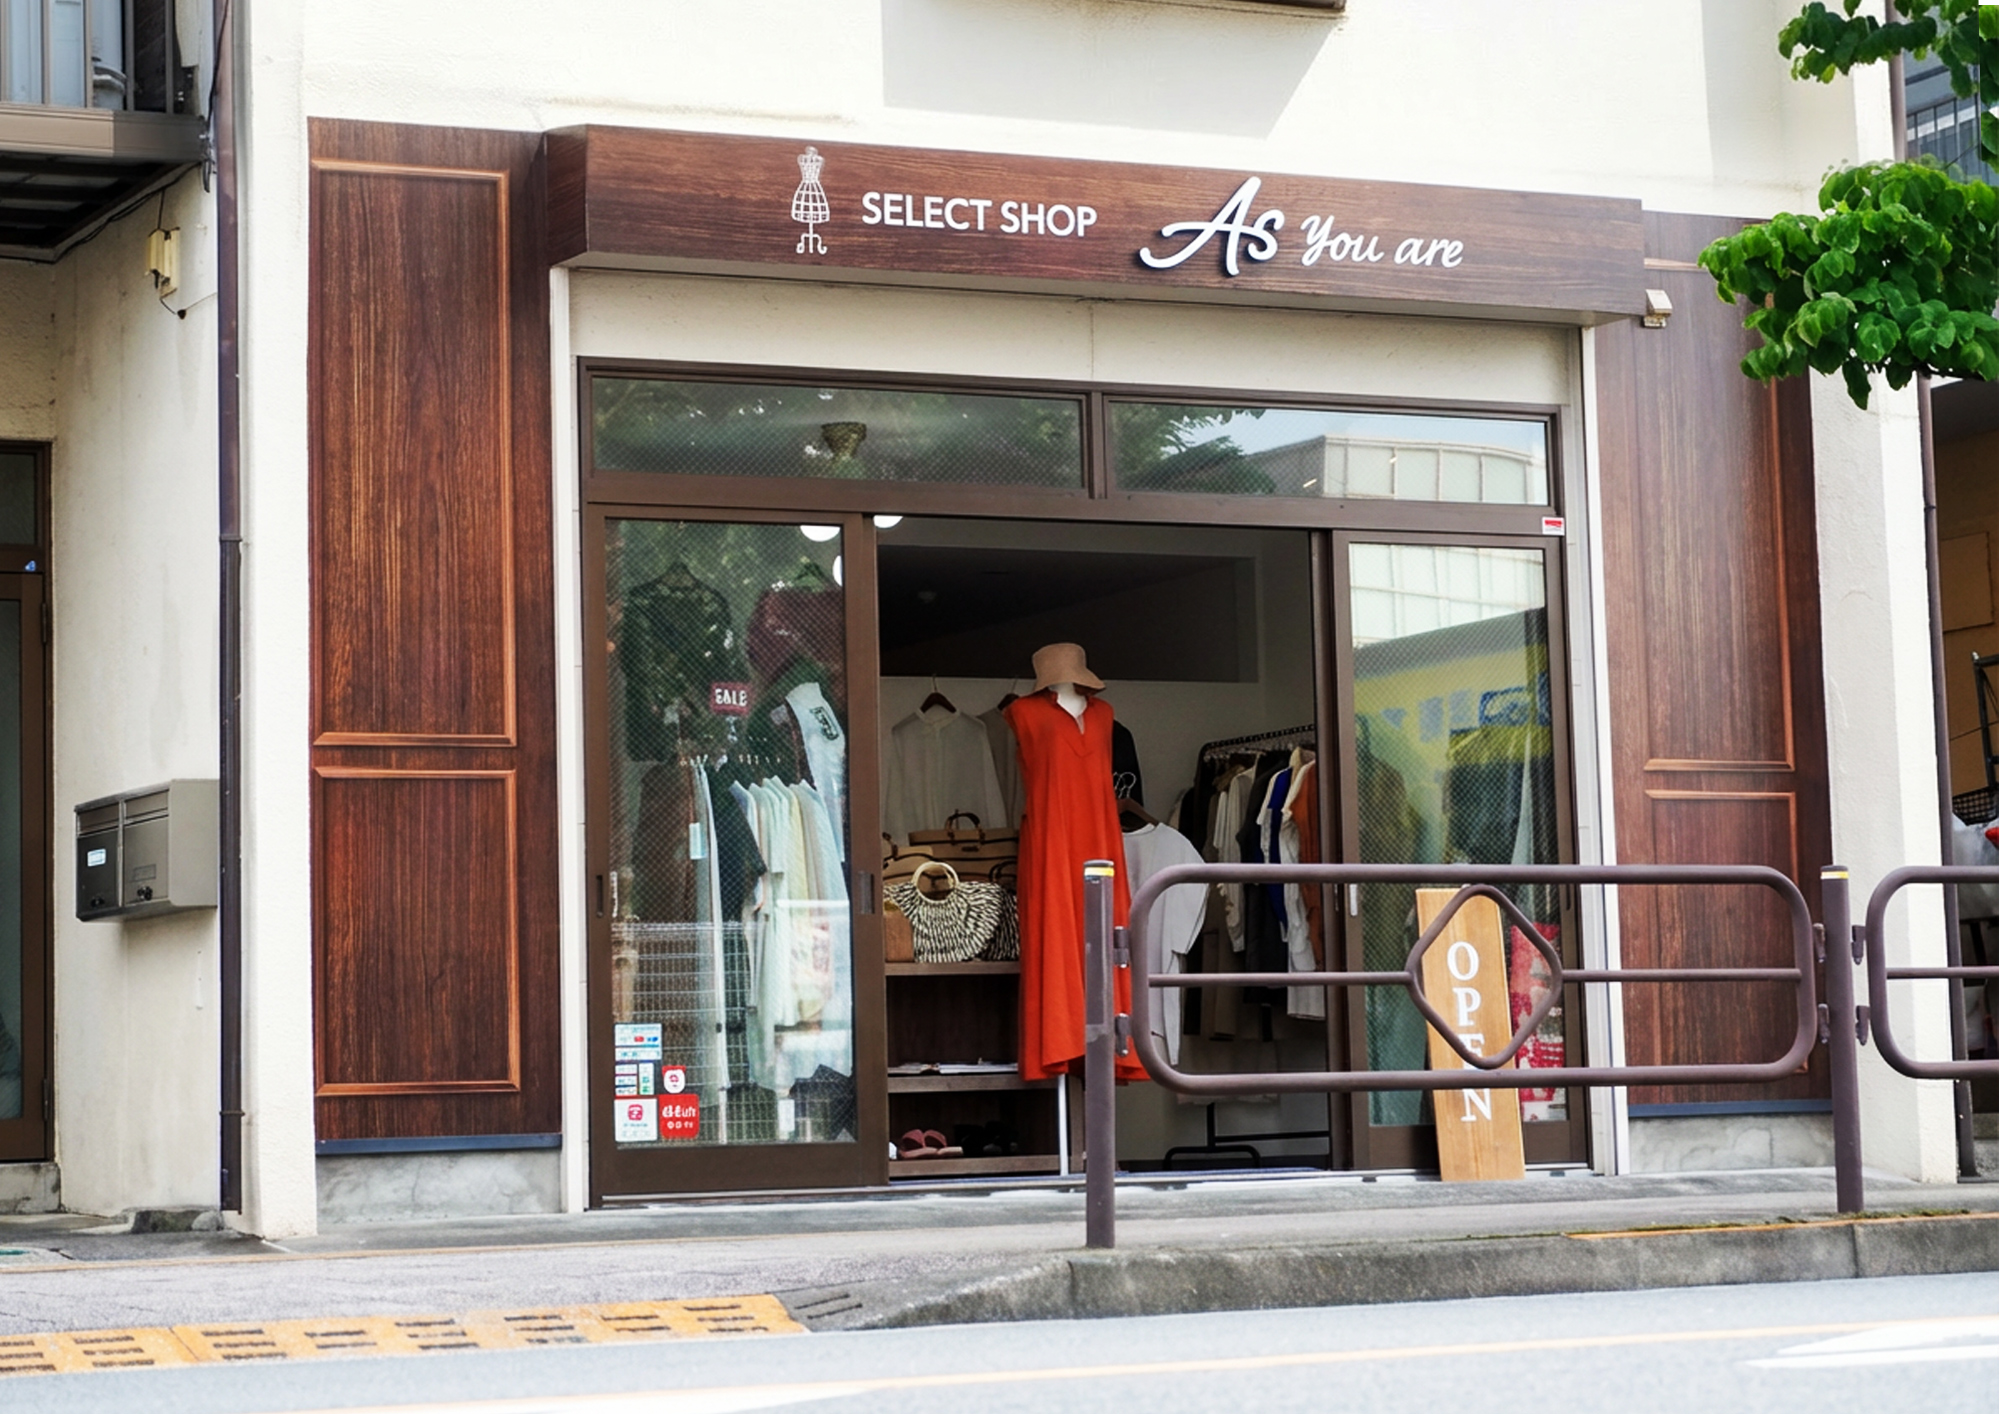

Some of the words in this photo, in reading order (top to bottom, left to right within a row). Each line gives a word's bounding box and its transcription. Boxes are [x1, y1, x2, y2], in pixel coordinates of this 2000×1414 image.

[861, 191, 993, 229] SELECT
[999, 201, 1098, 237] SHOP
[1139, 176, 1286, 275] As
[1300, 214, 1386, 268] You
[1392, 236, 1466, 270] are
